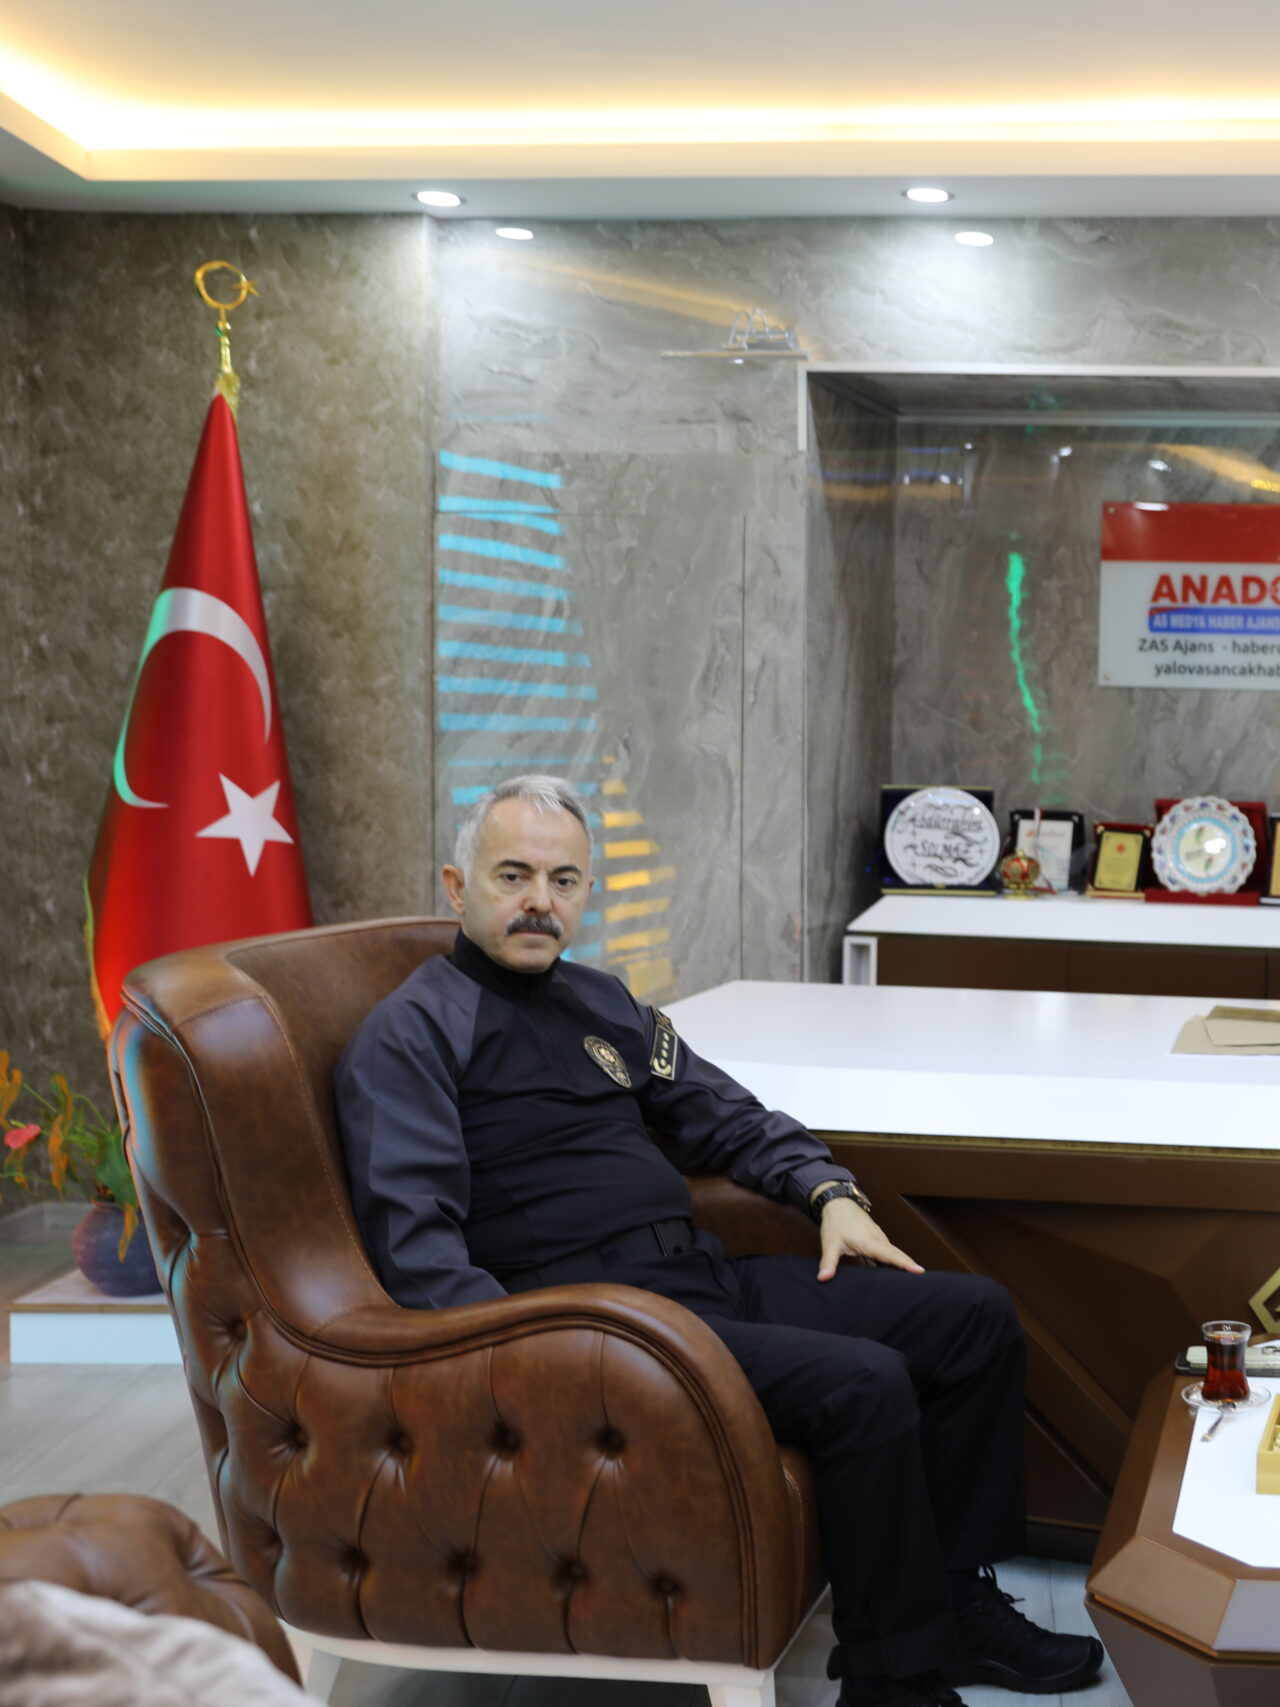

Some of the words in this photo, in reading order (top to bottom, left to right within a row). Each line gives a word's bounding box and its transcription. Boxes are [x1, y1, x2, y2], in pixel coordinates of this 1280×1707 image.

[1154, 614, 1168, 628] AS
[1170, 613, 1204, 630] MEDYA
[1207, 614, 1244, 630] HABER
[1138, 639, 1169, 652] ZAS
[1173, 639, 1215, 656] Ajans
